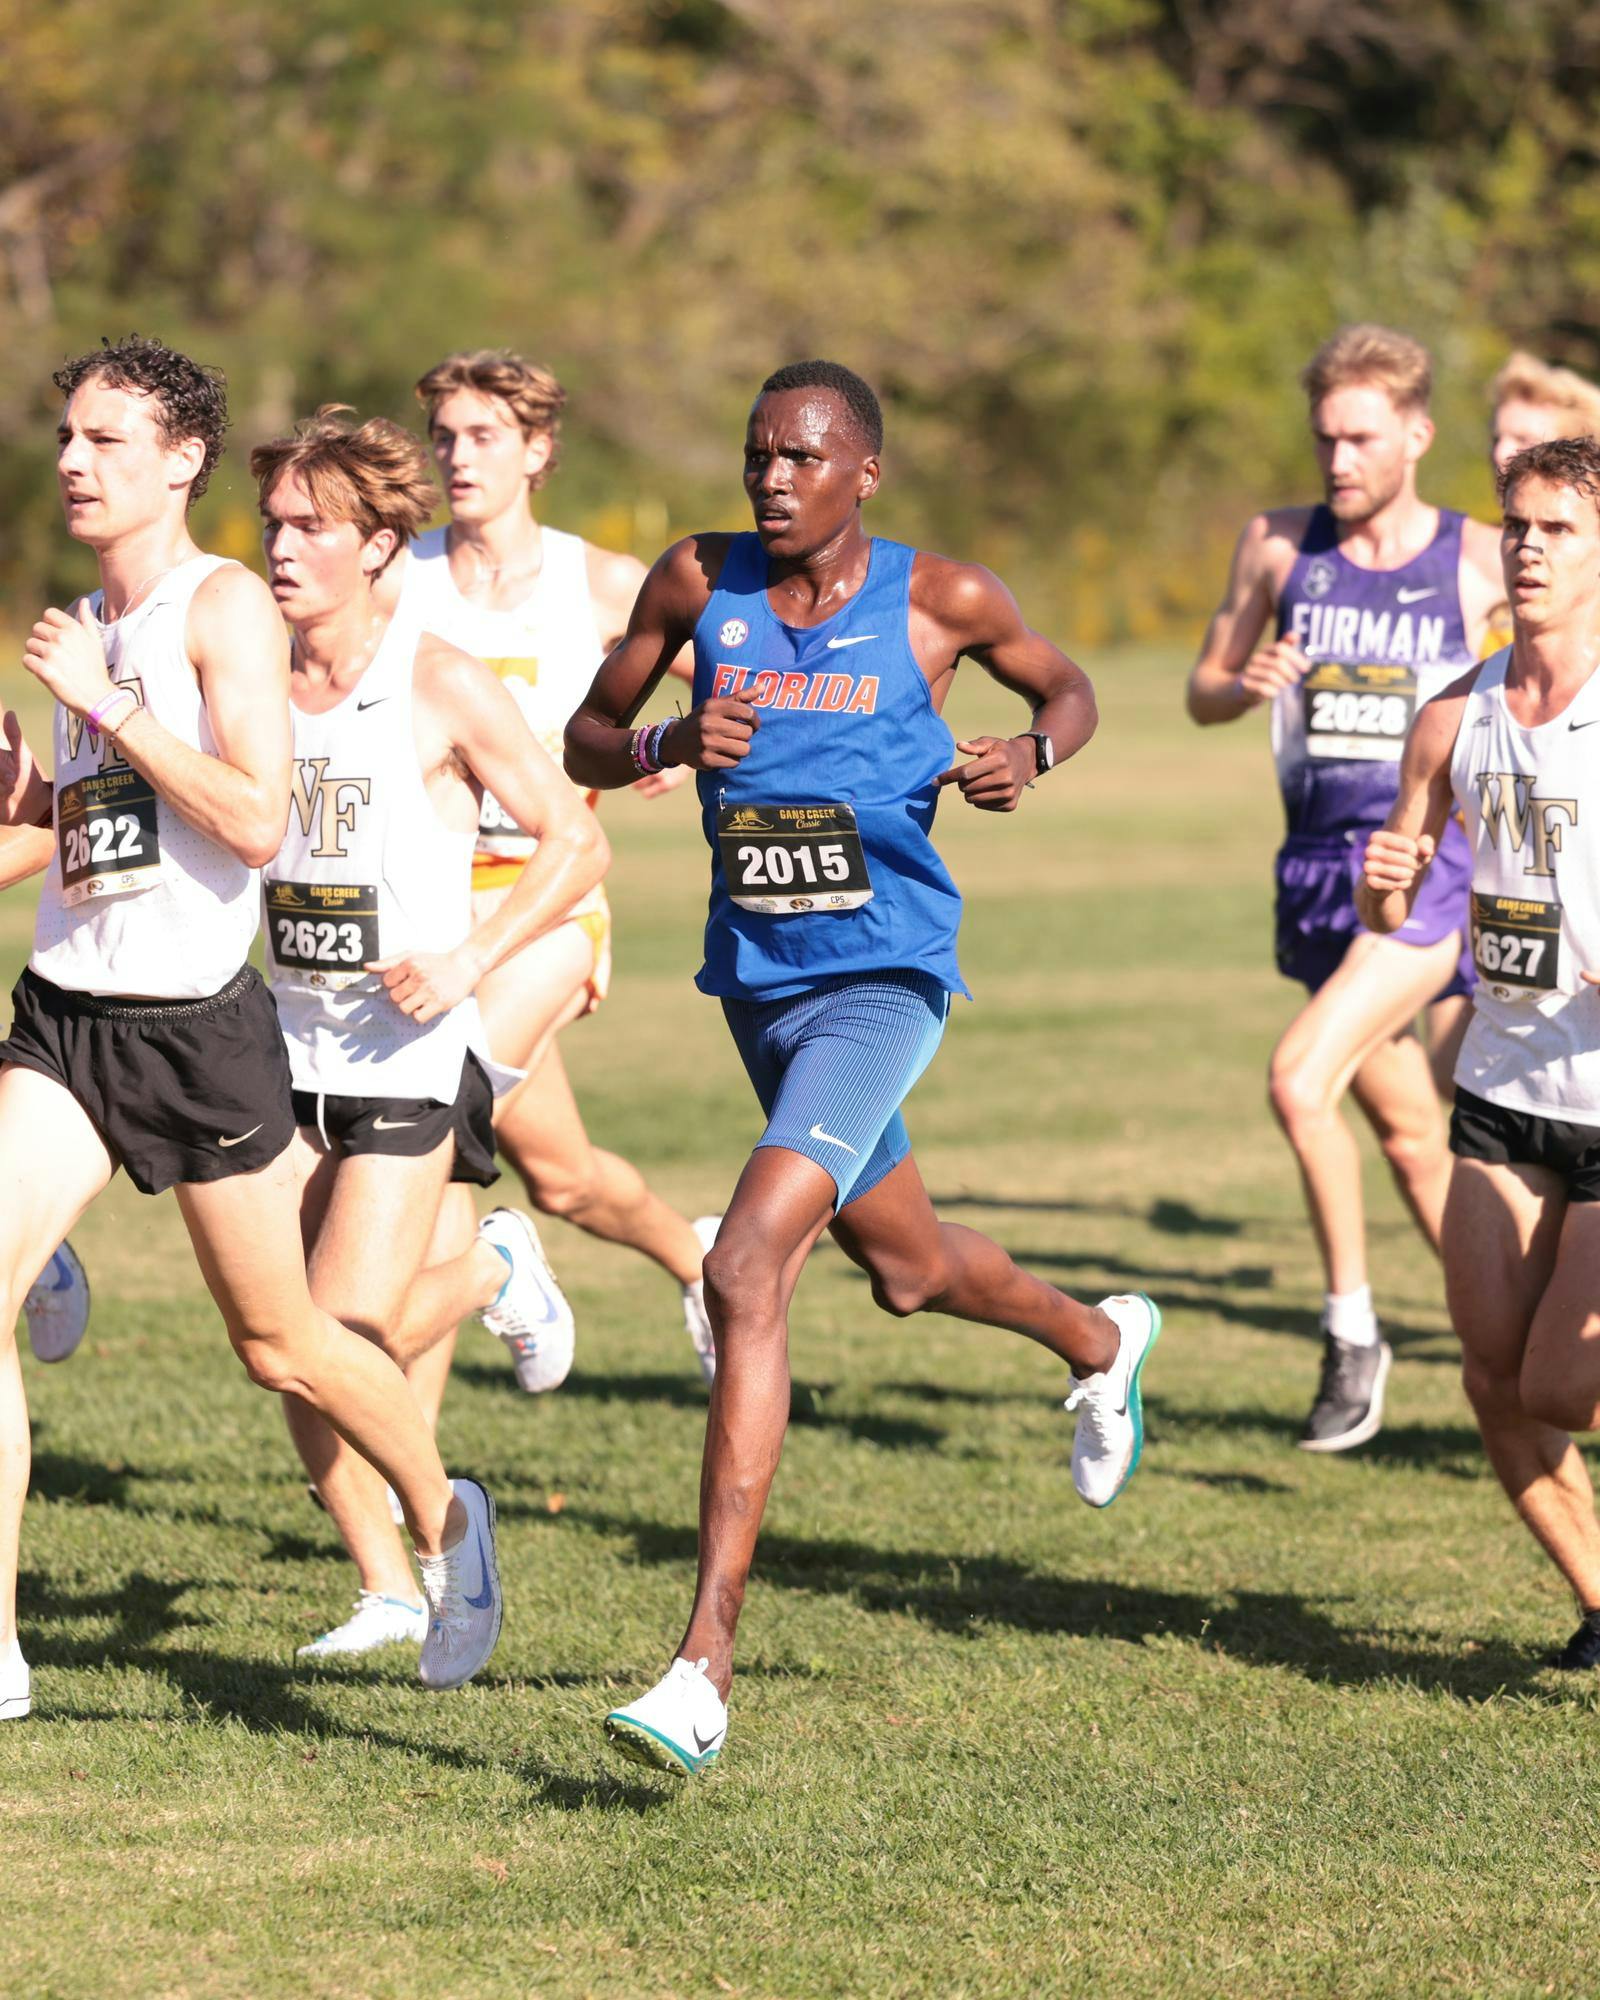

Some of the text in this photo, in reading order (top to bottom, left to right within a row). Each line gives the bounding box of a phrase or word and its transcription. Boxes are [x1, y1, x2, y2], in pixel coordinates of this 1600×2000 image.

[720, 620, 746, 645] SEC
[1292, 602, 1445, 662] FURMAN
[711, 663, 880, 715] FLORIDA
[1310, 690, 1408, 735] 2028
[81, 773, 135, 793] GANS CREEK
[288, 757, 371, 857] WF
[779, 808, 837, 820] GANS CREEK
[796, 818, 821, 830] Classic
[1475, 771, 1578, 878] WF
[65, 814, 143, 873] 2622
[737, 844, 850, 885] 2015
[333, 887, 361, 898] CREEK
[830, 895, 845, 904] CPS
[277, 918, 364, 963] 2623
